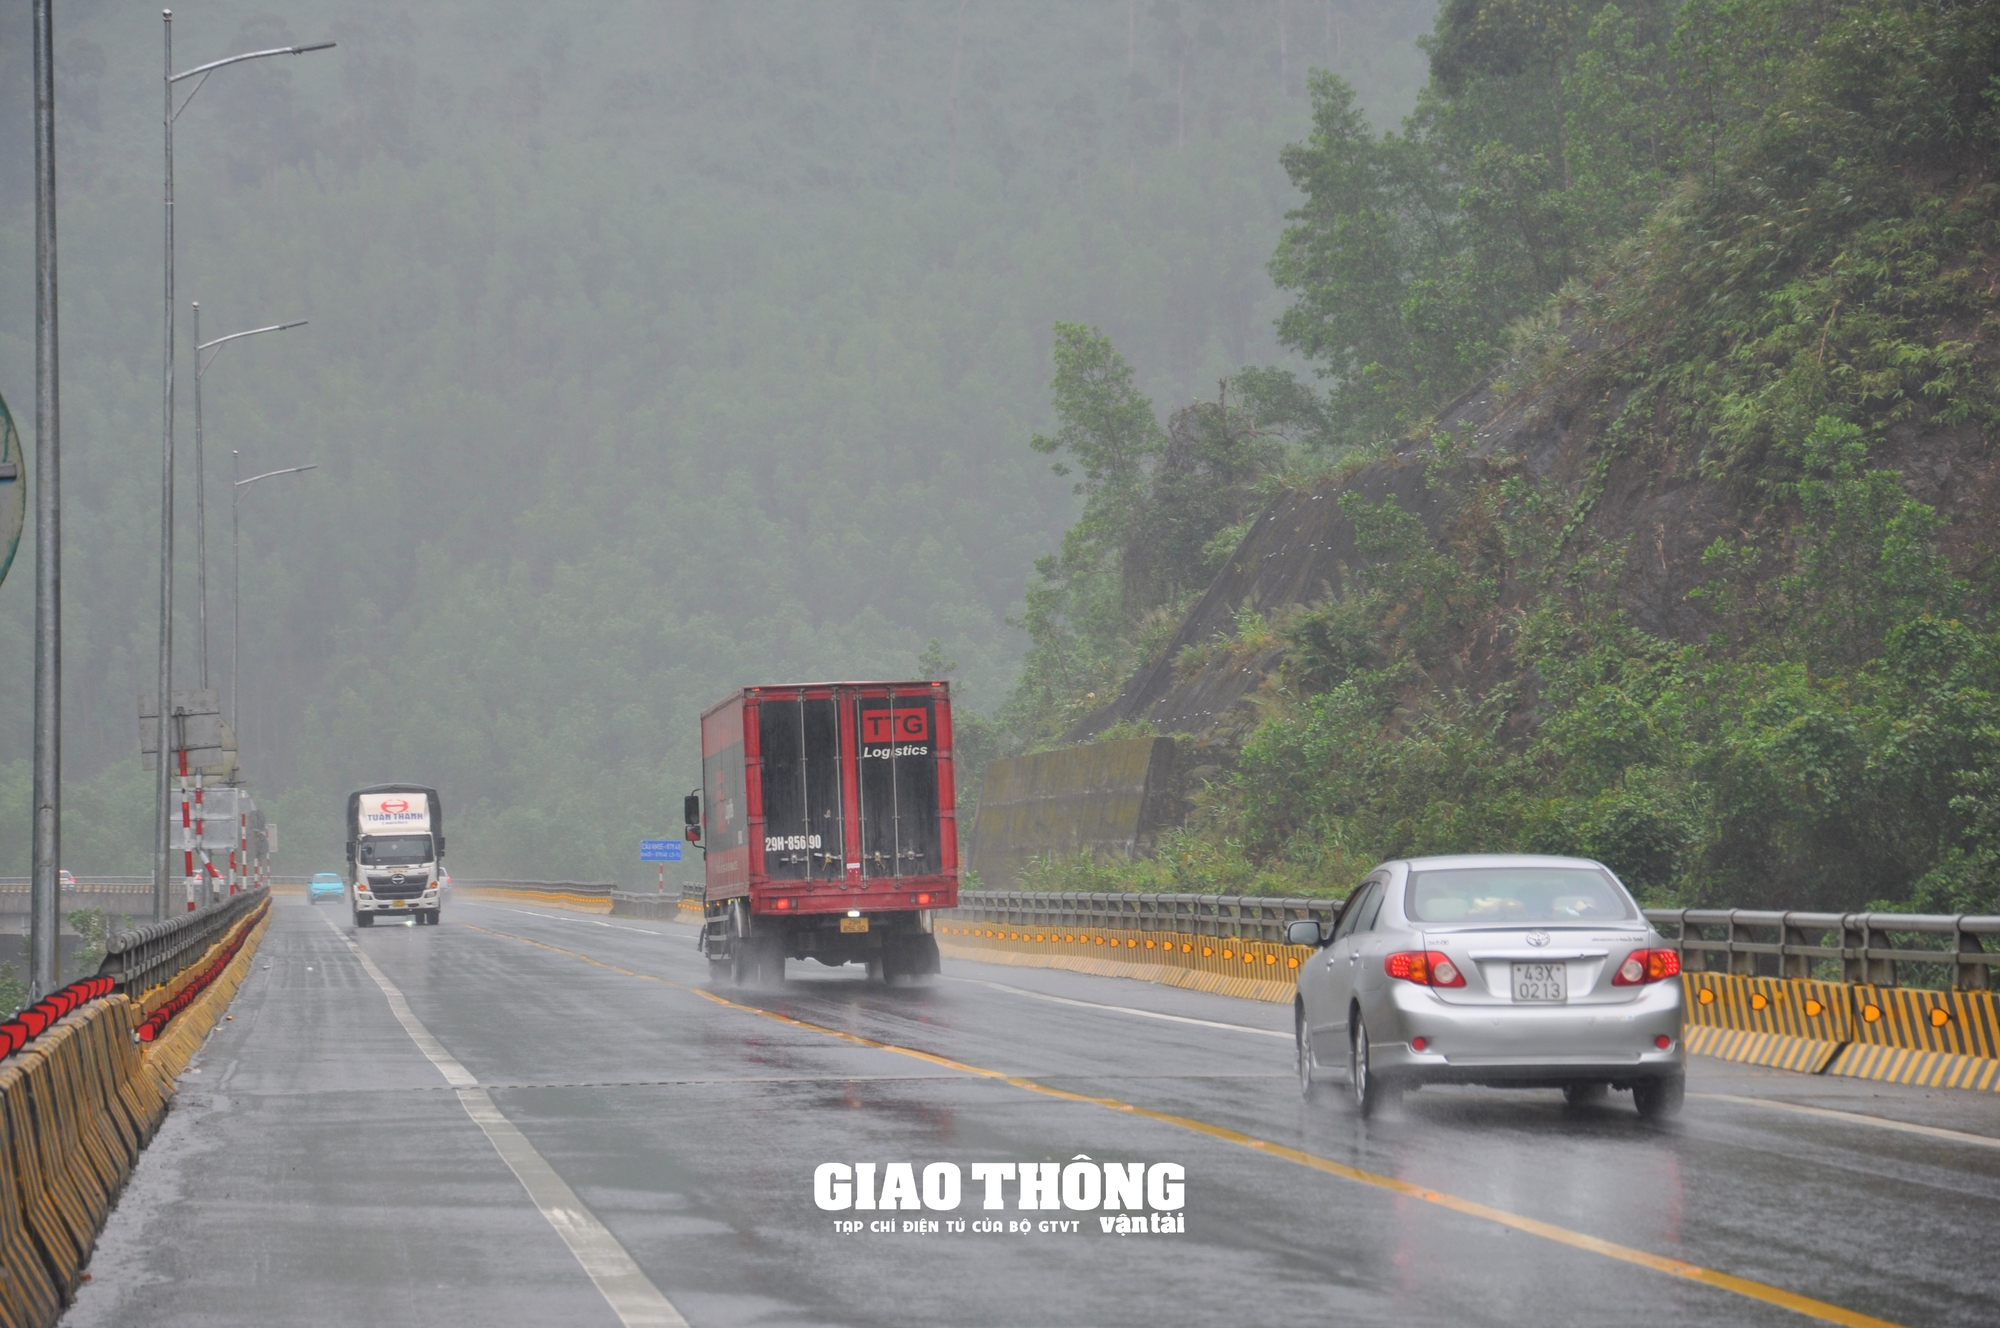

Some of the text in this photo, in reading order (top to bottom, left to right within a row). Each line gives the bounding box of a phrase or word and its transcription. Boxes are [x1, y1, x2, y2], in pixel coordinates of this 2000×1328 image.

[867, 714, 923, 736] TTG
[1525, 965, 1554, 982] 43X
[1519, 982, 1560, 999] 0213
